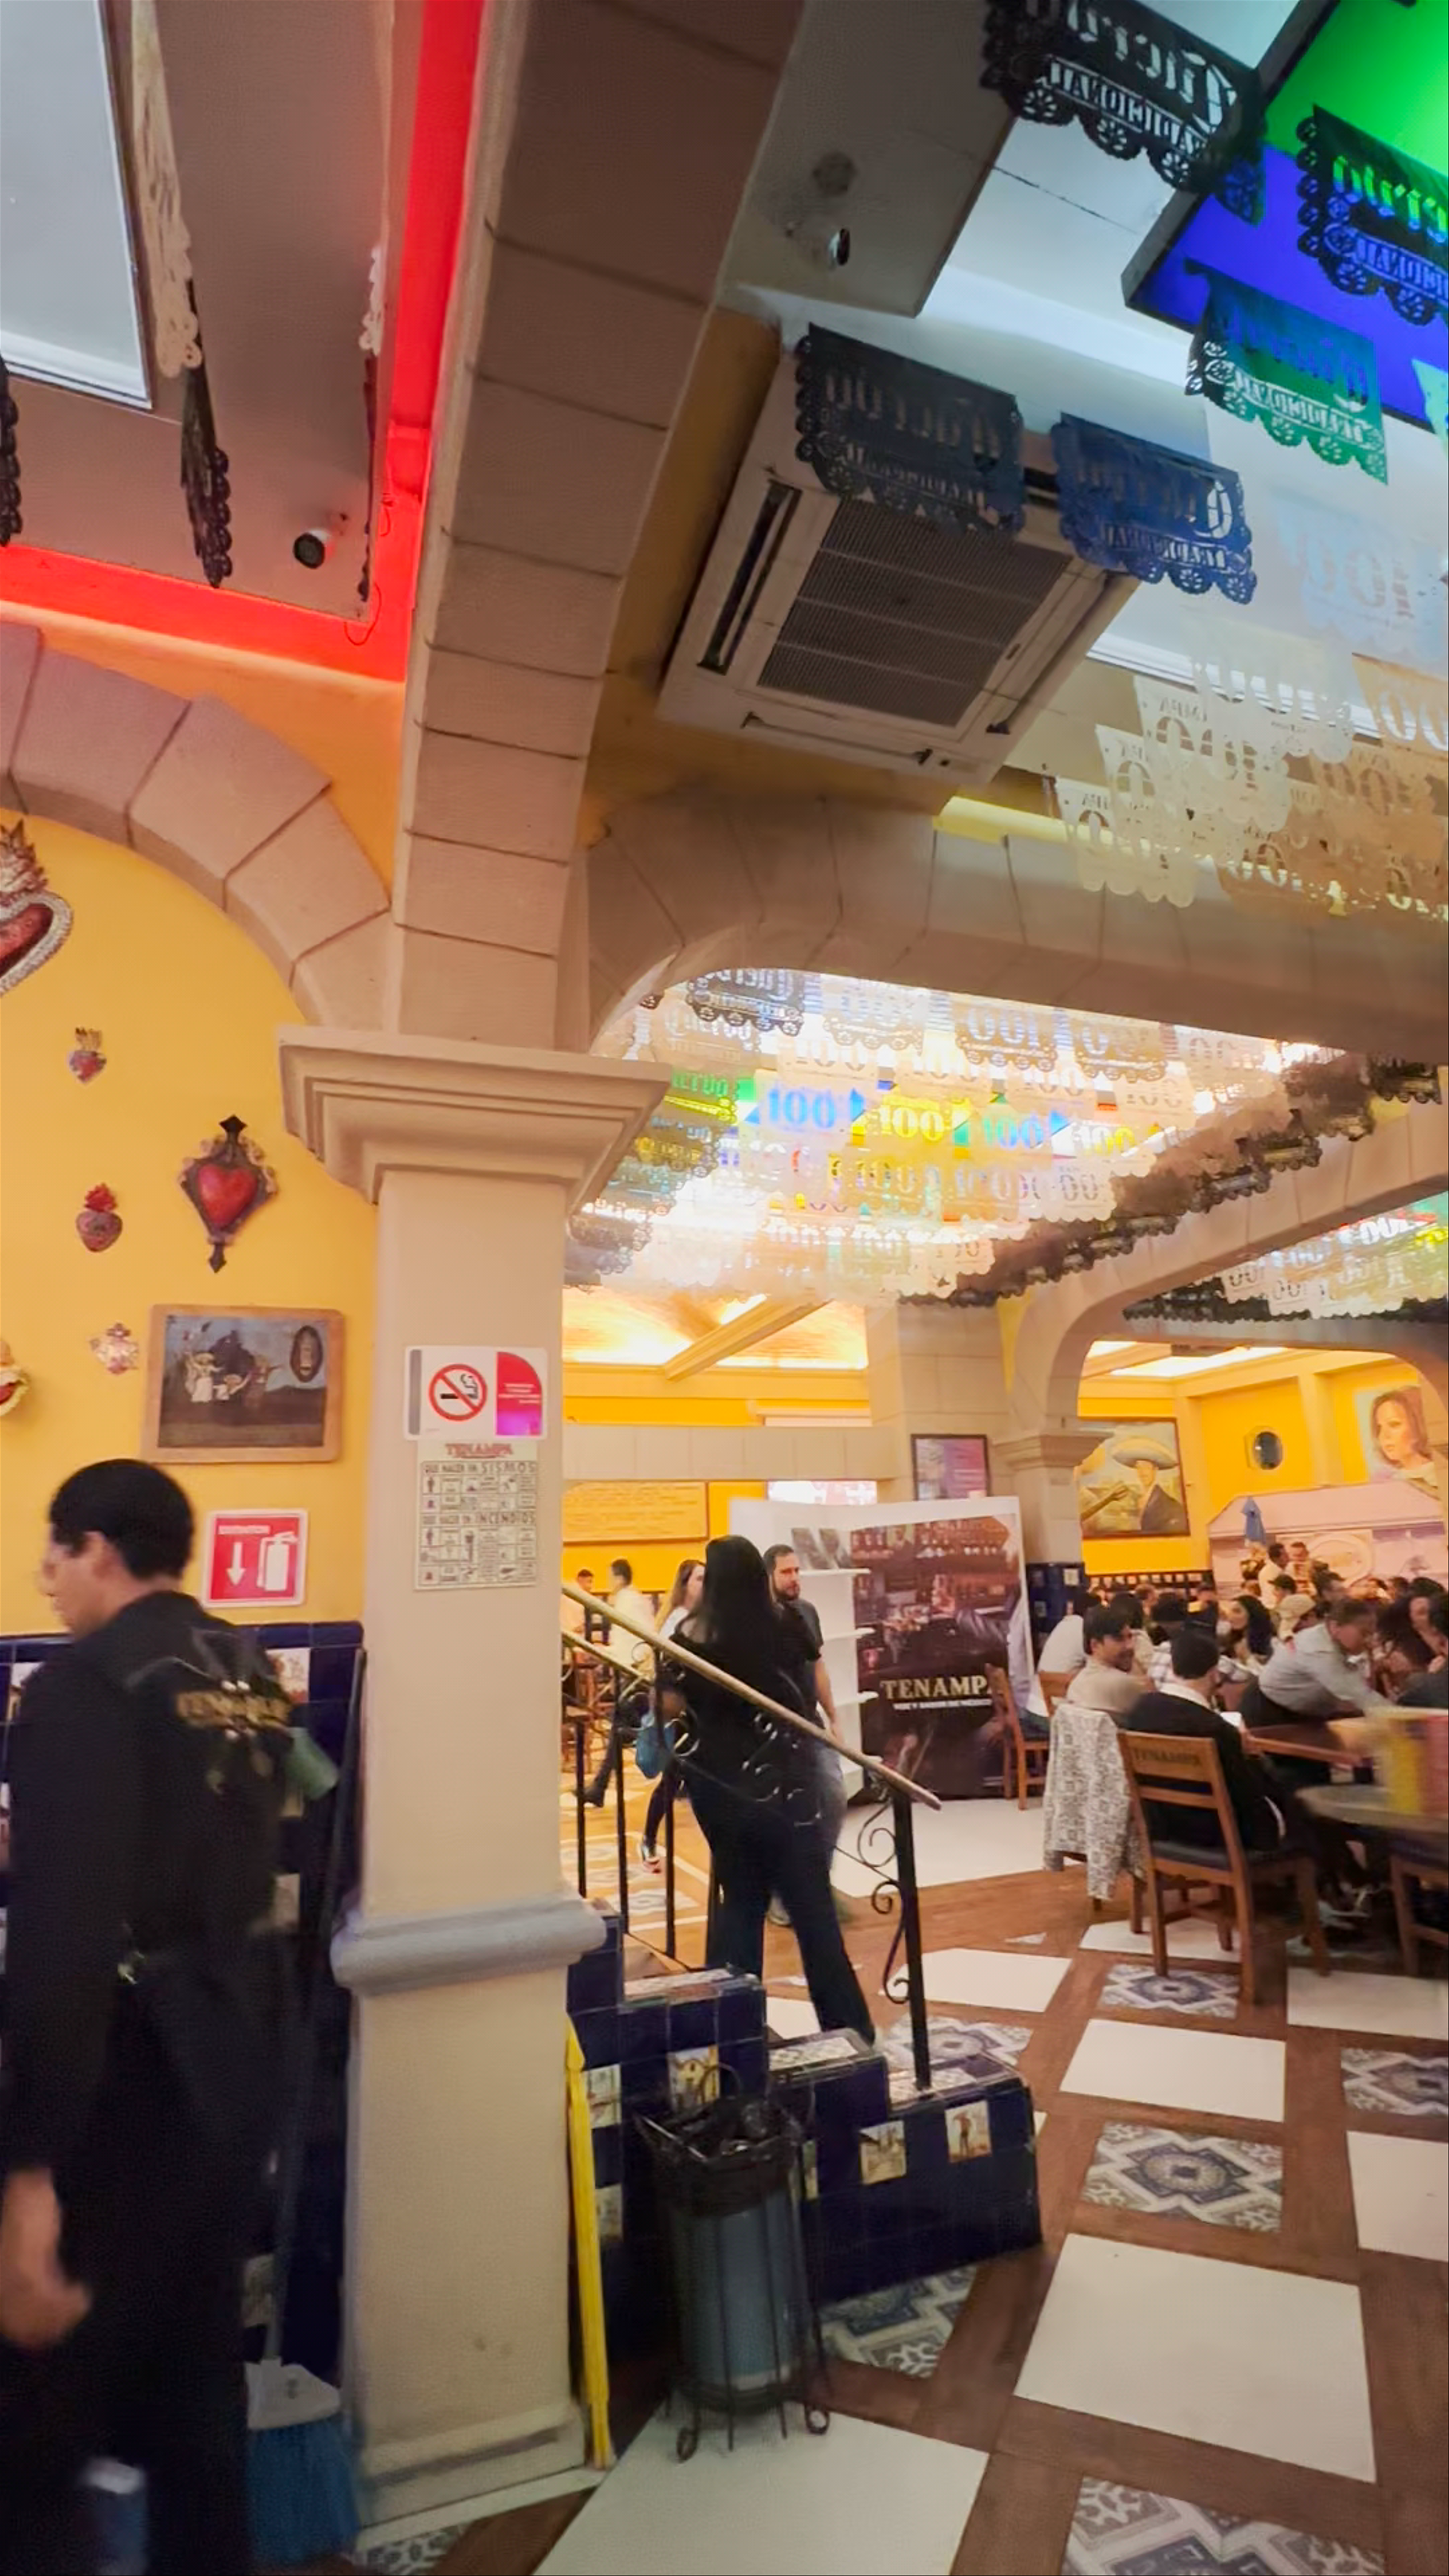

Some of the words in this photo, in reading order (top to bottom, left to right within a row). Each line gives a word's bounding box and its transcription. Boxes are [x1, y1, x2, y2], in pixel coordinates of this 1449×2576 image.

[768, 1088, 836, 1129] 100
[879, 1103, 945, 1141] 100
[982, 1115, 1043, 1148] 100
[481, 1462, 536, 1473] SISMOS
[879, 1675, 992, 1700] TENAMP
